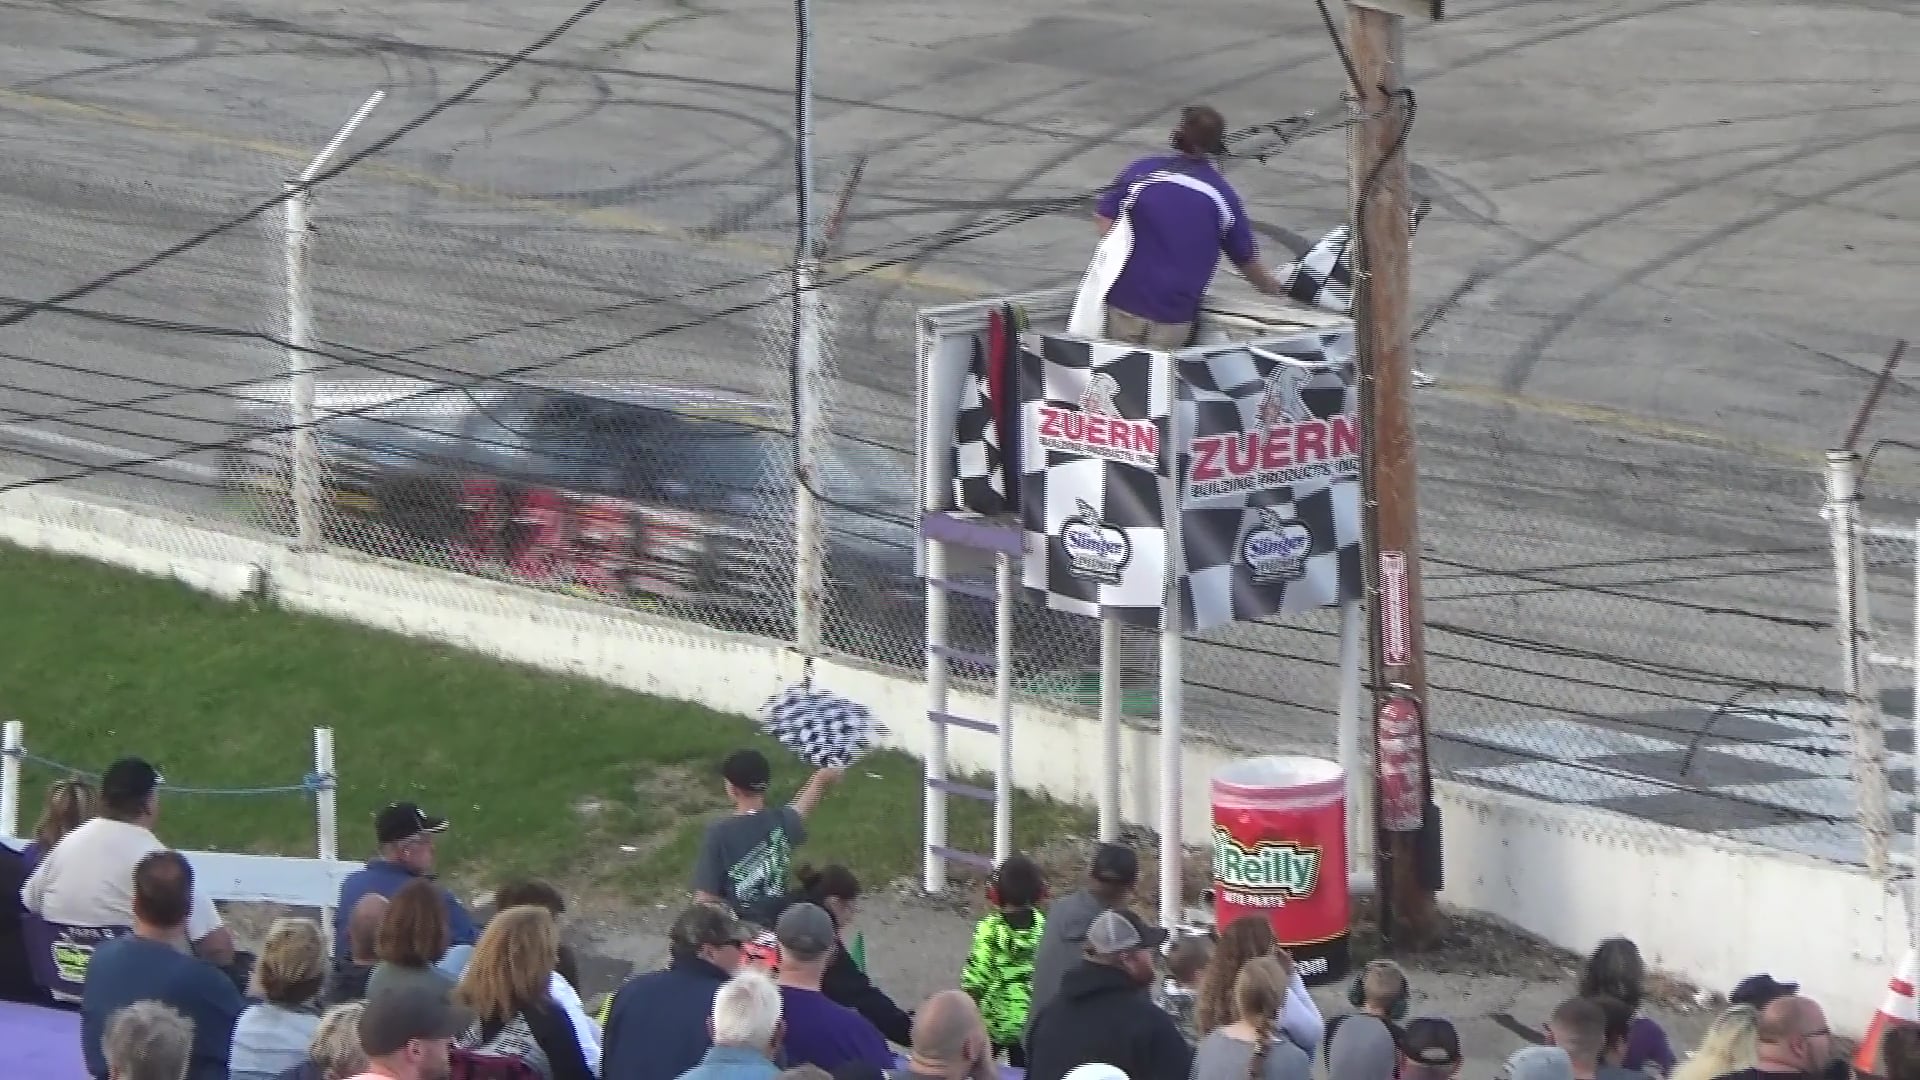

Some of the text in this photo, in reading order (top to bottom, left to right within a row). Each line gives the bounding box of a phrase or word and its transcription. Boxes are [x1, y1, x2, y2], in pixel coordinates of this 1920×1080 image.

[1038, 409, 1157, 455] ZUERN
[1039, 436, 1084, 453] BUILDING
[1190, 415, 1359, 483] ZUERN
[1191, 477, 1256, 498] BUILDING
[1067, 529, 1125, 559] Slinger
[1248, 535, 1308, 560] Slinger
[1075, 554, 1115, 571] SPEEDWAY
[1222, 892, 1285, 910] AUTO PARTS
